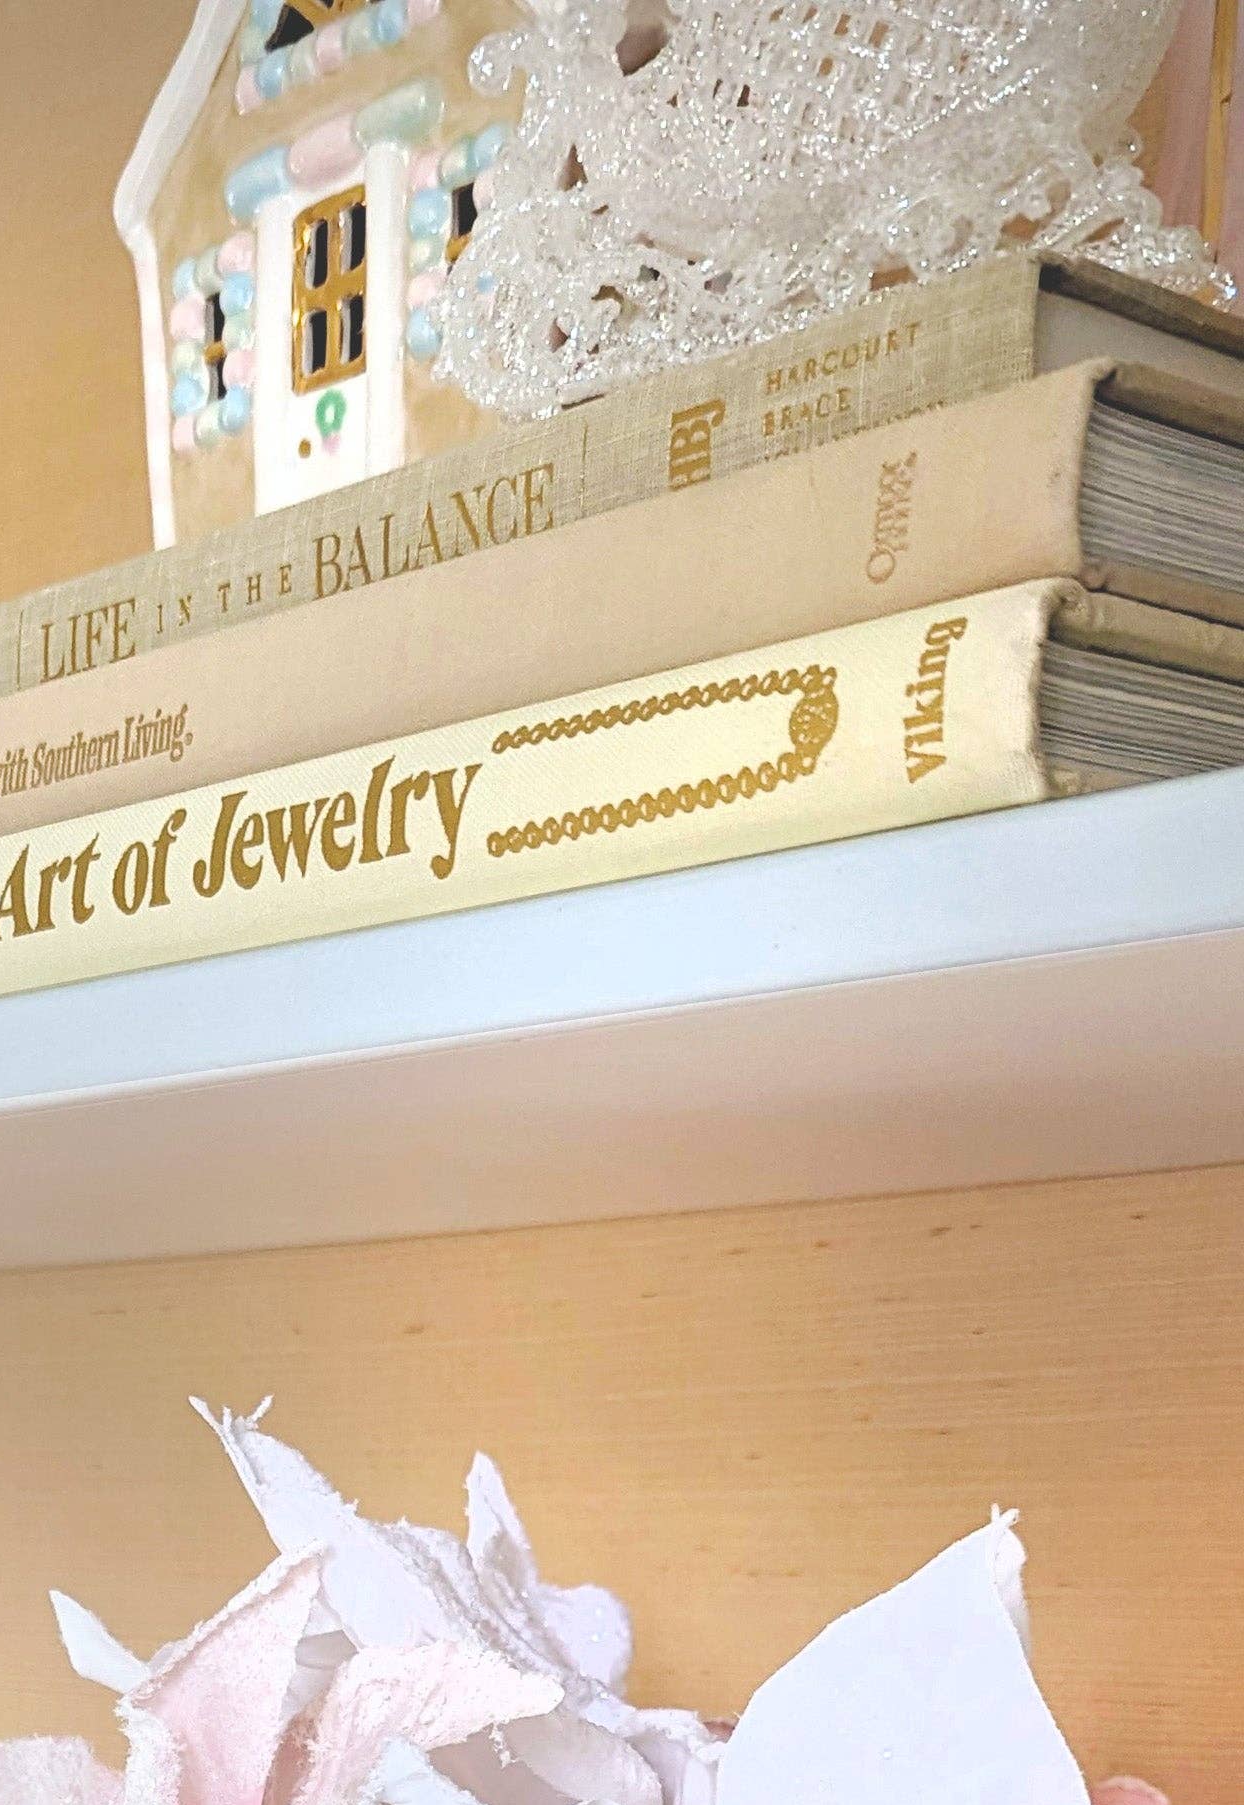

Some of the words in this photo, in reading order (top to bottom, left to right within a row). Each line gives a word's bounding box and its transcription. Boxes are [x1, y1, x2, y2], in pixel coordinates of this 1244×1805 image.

[764, 321, 922, 396] HARCOURT
[668, 399, 726, 492] HBJ
[763, 386, 851, 438] BRACE
[40, 597, 136, 684] LIFE
[156, 595, 192, 633] IN
[217, 563, 293, 612] THE
[312, 463, 555, 600] BALANCE
[903, 616, 968, 785] Viking
[30, 729, 119, 788] Southern
[111, 808, 188, 916] of
[192, 754, 482, 897] Jewelry
